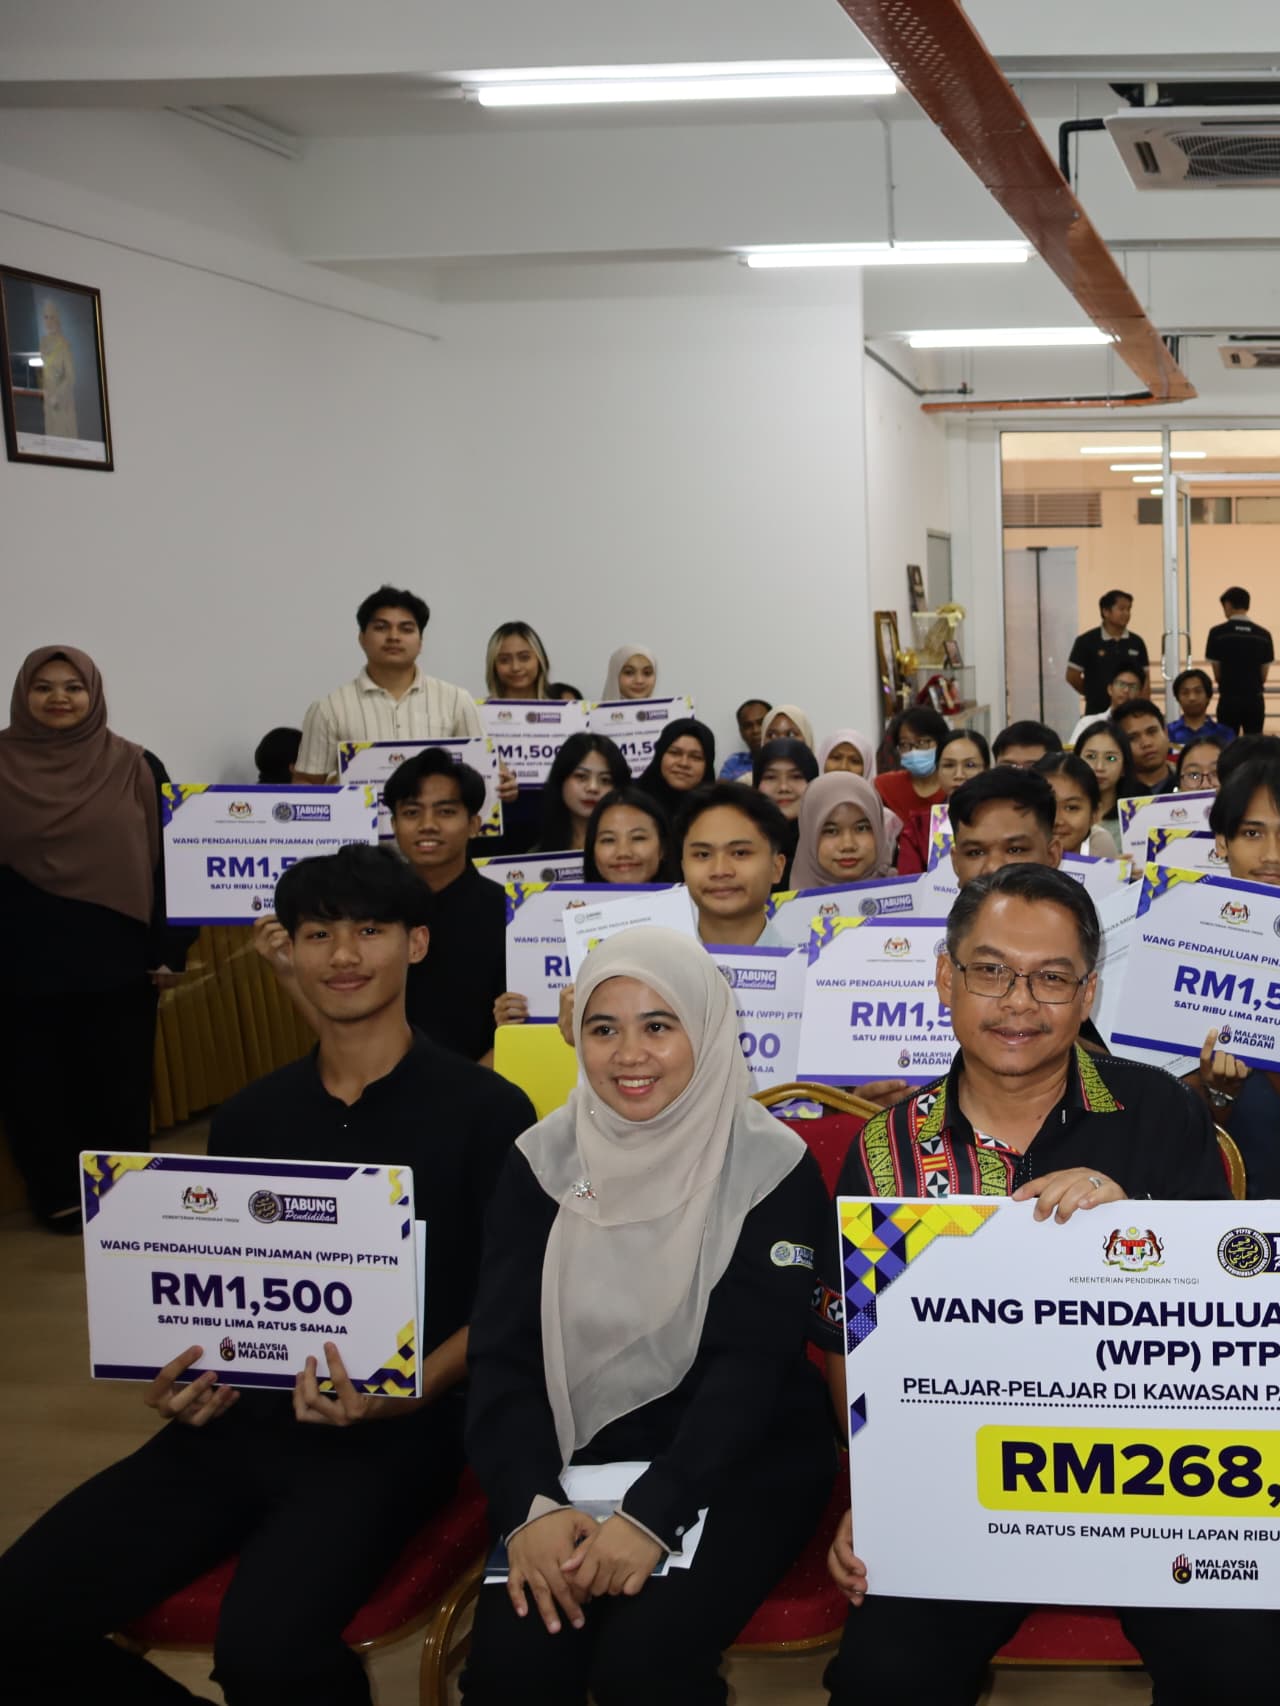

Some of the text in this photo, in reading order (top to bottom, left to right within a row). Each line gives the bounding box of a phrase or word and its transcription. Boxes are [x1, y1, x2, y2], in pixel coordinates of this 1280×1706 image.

[498, 745, 561, 760] M1,500
[296, 805, 330, 815] TABUNG
[207, 857, 300, 880] RM1,5
[879, 895, 912, 909] TABUNG
[1142, 933, 1175, 948] WANG
[1178, 940, 1258, 964] PENDAHULUAN
[737, 971, 776, 982] TABUNG
[816, 979, 925, 988] WANG PENDAHULUAN
[757, 1010, 784, 1020] (WPP)
[850, 1001, 953, 1032] RM1,5
[1174, 1000, 1201, 1012] SATU
[1202, 1005, 1227, 1017] RIBU
[1228, 1009, 1253, 1021] LIMA
[930, 1034, 955, 1042] RATU
[1233, 1035, 1275, 1050] MADANI
[1234, 1029, 1275, 1042] MALAYSIA
[748, 1065, 774, 1073] HAJA
[284, 1197, 336, 1212] TABUNG
[284, 1209, 336, 1223] Pendidikan
[100, 1240, 398, 1266] WANG PENDAHULUAN PINJAMAN (WPP) PTPTN
[1069, 1276, 1124, 1284] KEMENTERIAN
[151, 1271, 352, 1317] RM1,500
[910, 1296, 1023, 1325] WANG
[158, 1314, 348, 1335] SATU RIBU LIMA RATUS SAHAJA
[238, 1340, 288, 1351] MALAYSIA
[238, 1349, 288, 1361] MADANI
[1096, 1339, 1200, 1373] (WPP)
[902, 1377, 1107, 1399] PELAJAR-PELAJAR
[1114, 1383, 1136, 1400] DI
[1143, 1383, 1258, 1401] KAWASAN
[988, 1522, 1021, 1536] DUA
[1025, 1524, 1076, 1537] RATUS
[1081, 1525, 1126, 1538] ENAM
[1130, 1527, 1183, 1540] PULUH
[1188, 1528, 1238, 1541] LAPAN
[1244, 1530, 1280, 1542] RIBU
[1195, 1559, 1258, 1569] MALAYSIA
[1195, 1569, 1259, 1580] MADANI
